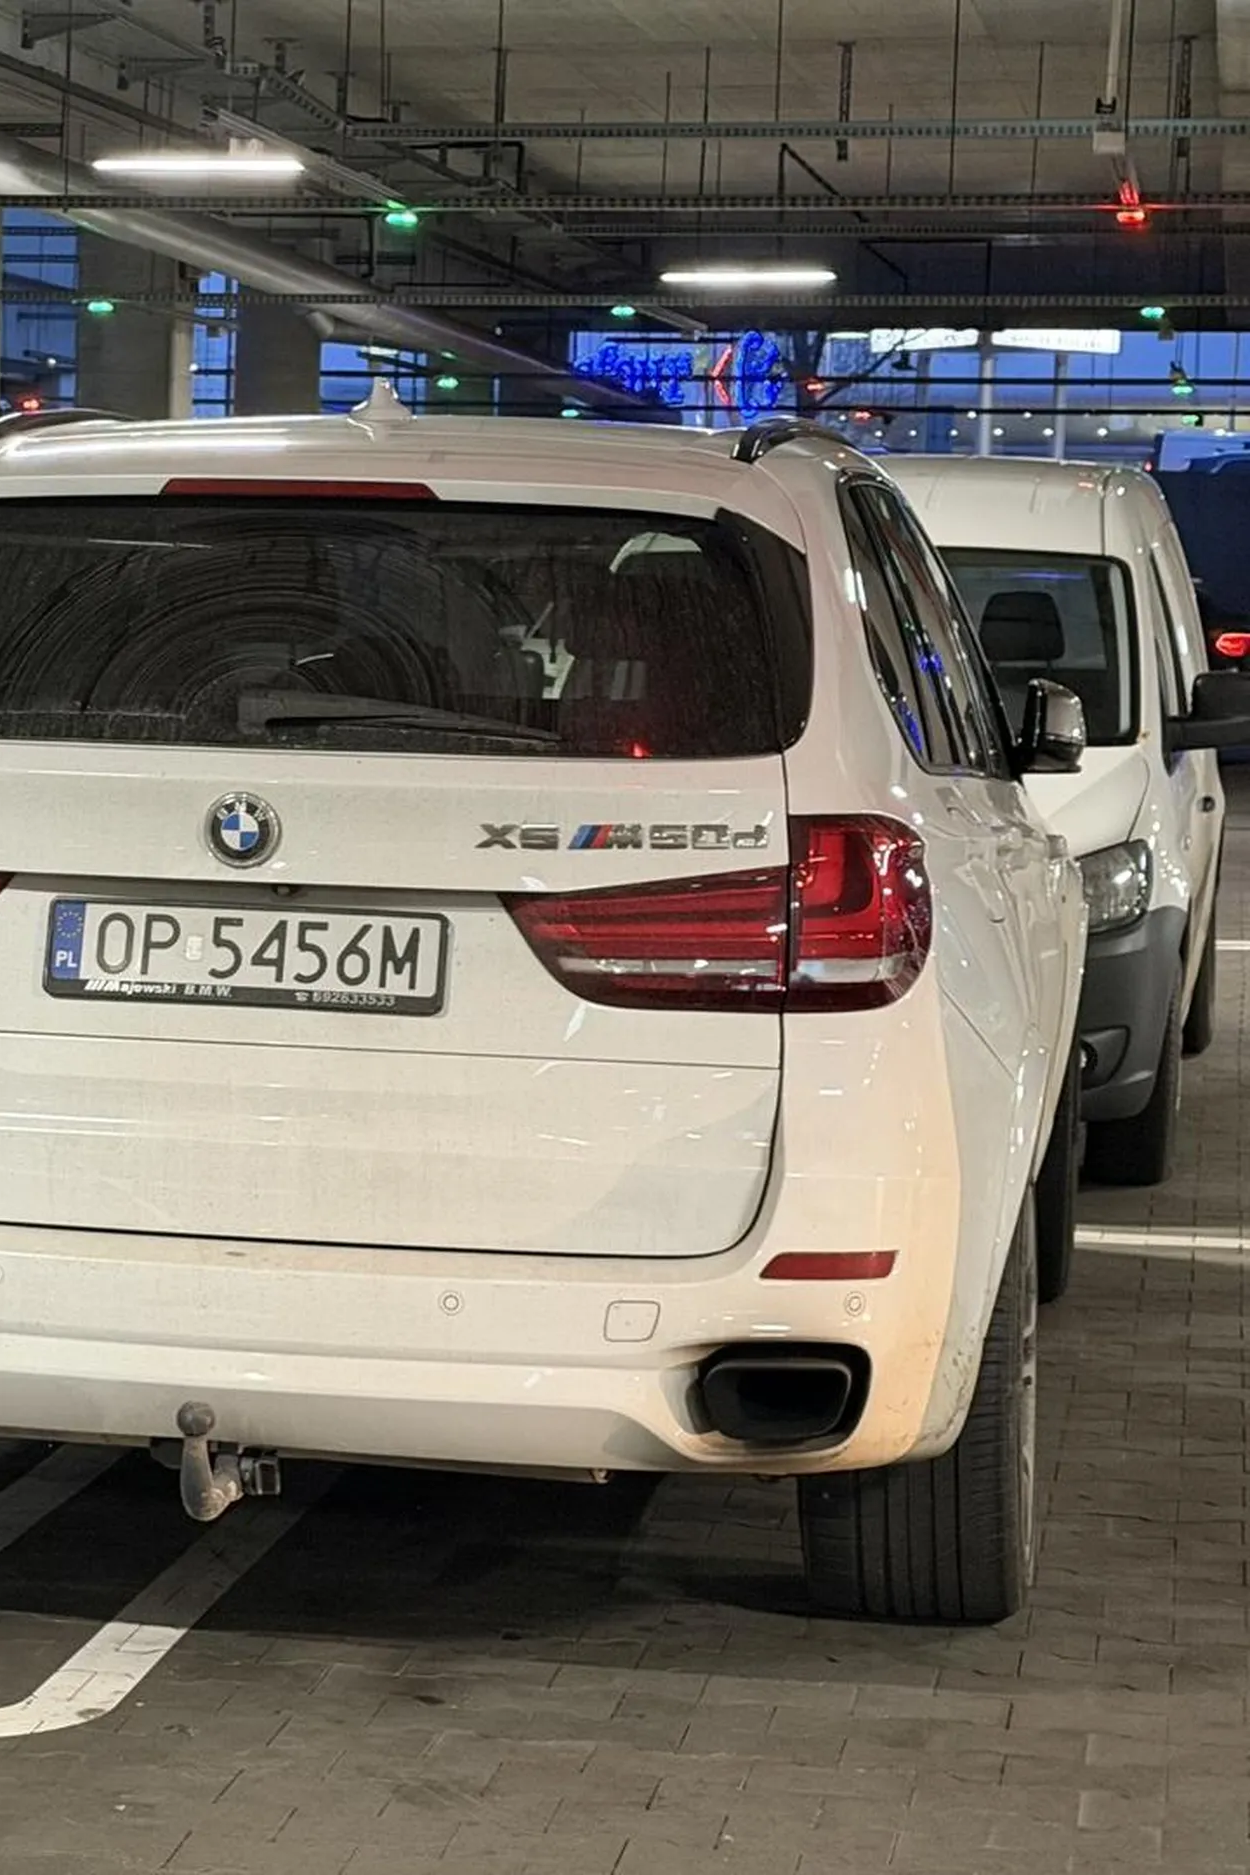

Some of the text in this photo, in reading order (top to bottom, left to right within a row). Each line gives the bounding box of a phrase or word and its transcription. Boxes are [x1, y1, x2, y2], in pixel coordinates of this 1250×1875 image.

[55, 950, 78, 968] PL
[95, 912, 421, 990] OP 5456M
